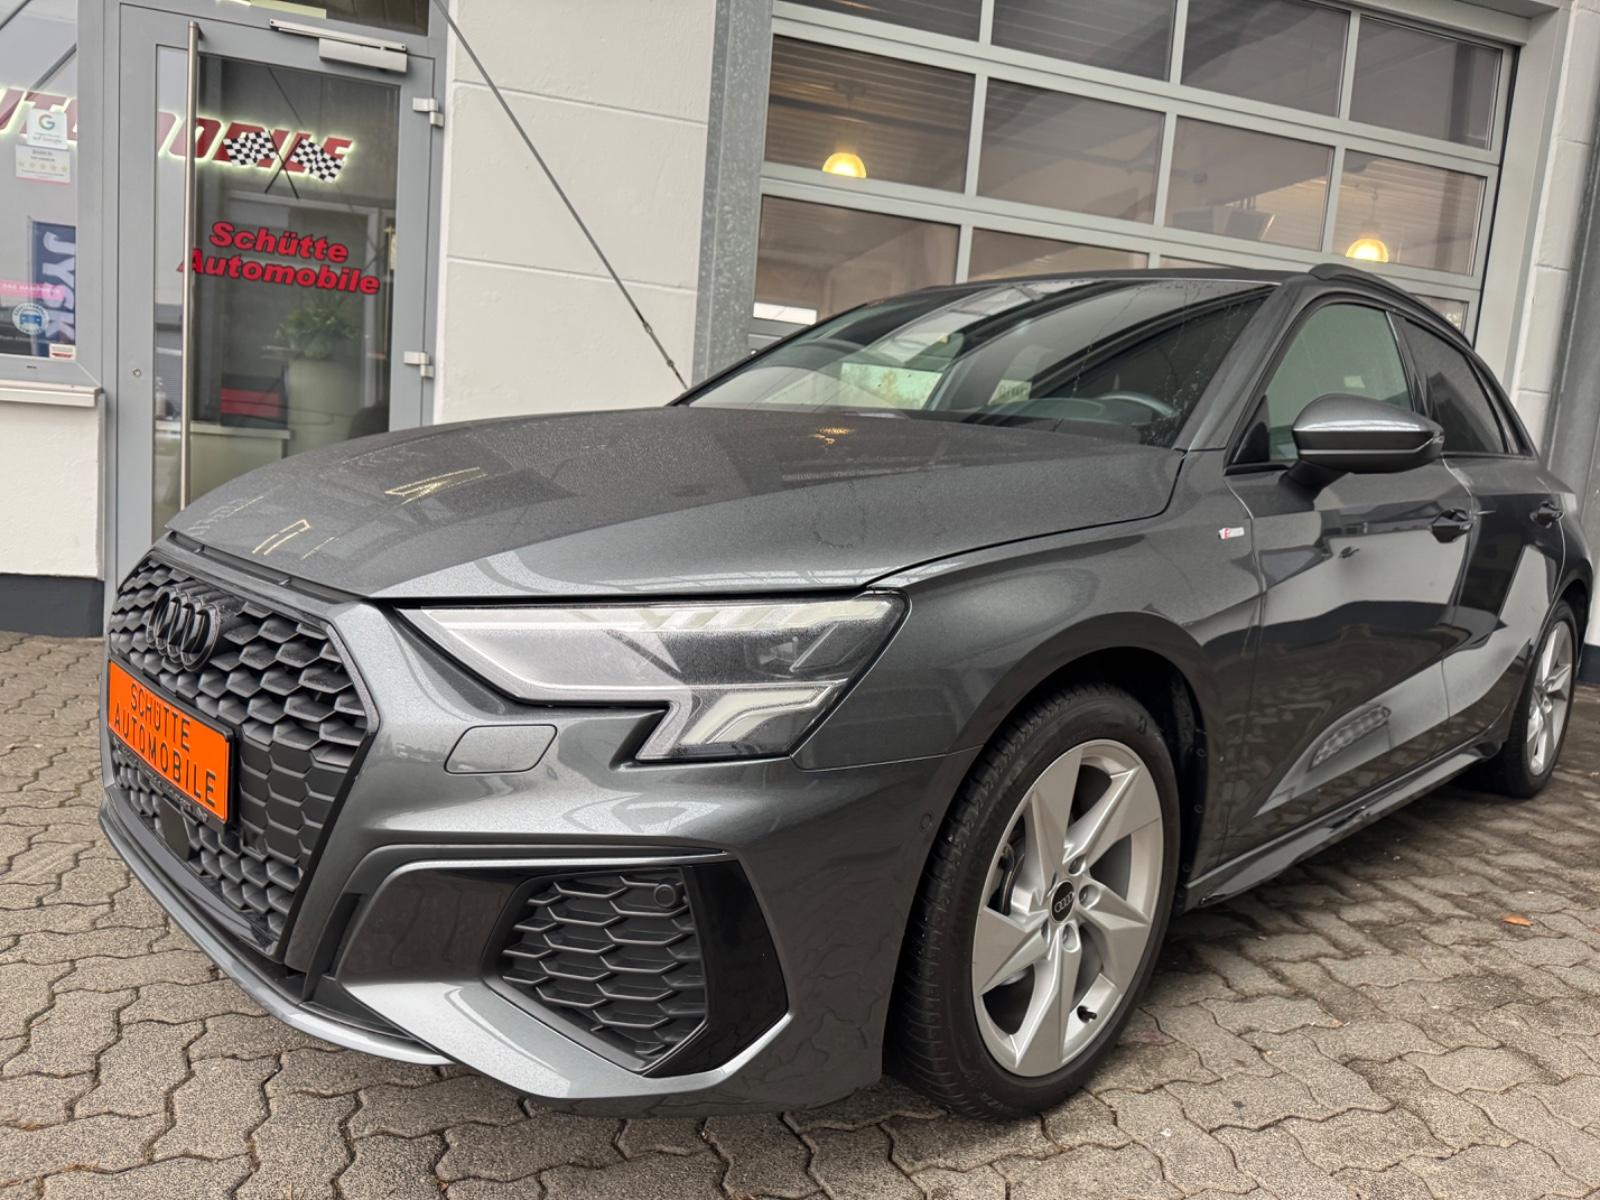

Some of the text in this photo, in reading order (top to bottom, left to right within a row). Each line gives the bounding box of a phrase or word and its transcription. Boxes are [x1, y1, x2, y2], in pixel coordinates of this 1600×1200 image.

[176, 247, 380, 295] Automobile
[209, 220, 349, 263] Schütte
[43, 231, 76, 341] JYSK
[131, 683, 190, 753] SCHÜTTE
[114, 703, 216, 808] AUTOMOBILE
